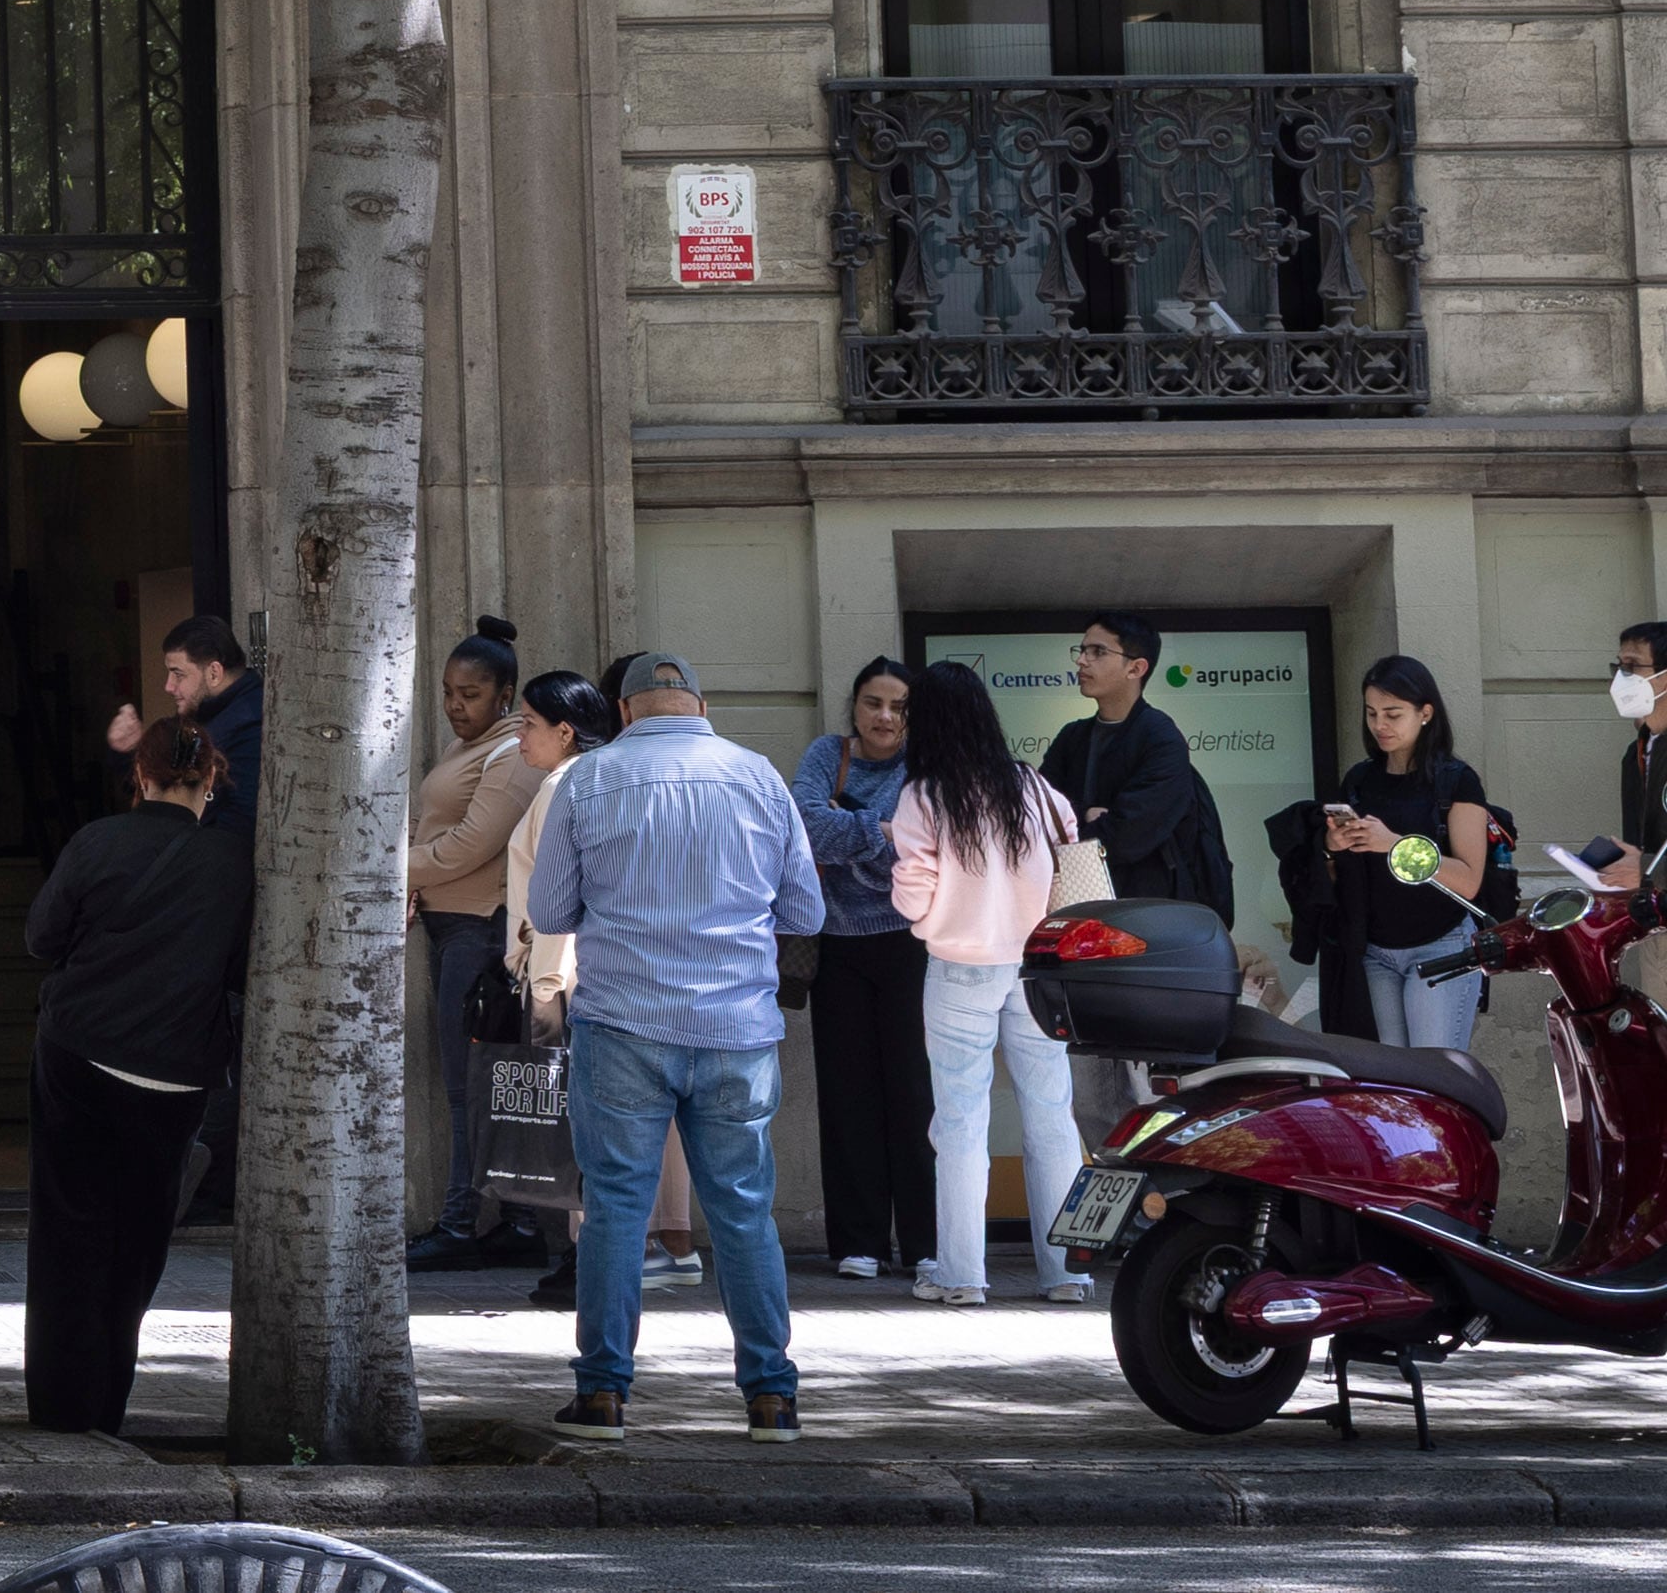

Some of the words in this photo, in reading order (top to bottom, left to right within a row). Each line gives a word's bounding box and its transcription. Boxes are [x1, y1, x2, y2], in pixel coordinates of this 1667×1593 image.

[700, 192, 729, 206] BPS
[688, 226, 705, 235] 902
[708, 226, 724, 235] 107
[727, 226, 744, 235] 720
[687, 245, 745, 254] CONNECTADA
[699, 237, 734, 245] ALARMA
[733, 254, 741, 262] A
[992, 671, 1063, 688] Centres
[1195, 665, 1293, 687] agrupació
[1186, 729, 1276, 752] dentista
[492, 1060, 564, 1091] SPORT
[491, 1085, 534, 1114] FOR
[536, 1090, 569, 1117] LIF
[1083, 1173, 1139, 1204] 7997
[1068, 1203, 1113, 1234] LHW
